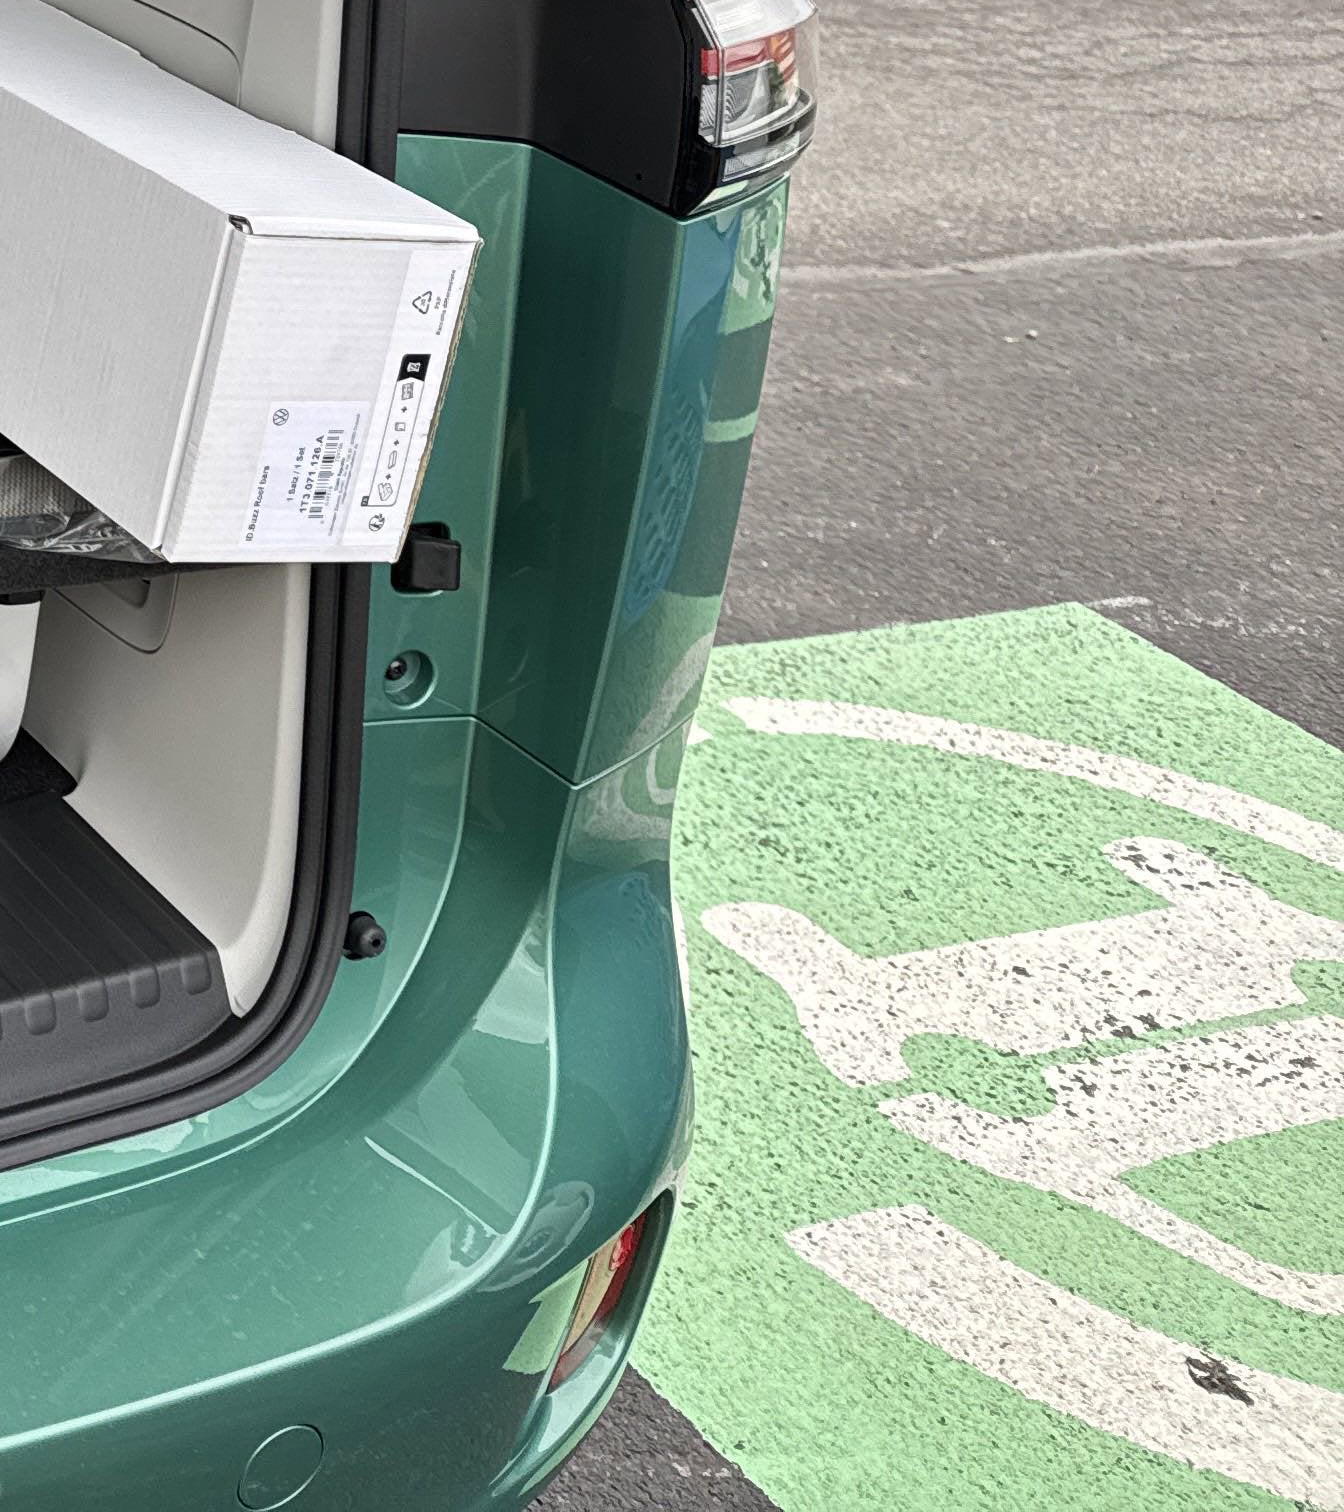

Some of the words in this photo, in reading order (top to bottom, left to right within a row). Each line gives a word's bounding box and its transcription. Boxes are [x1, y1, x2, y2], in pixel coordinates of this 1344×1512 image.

[296, 447, 306, 462] Set
[259, 465, 270, 485] bars
[254, 486, 265, 507] Roof
